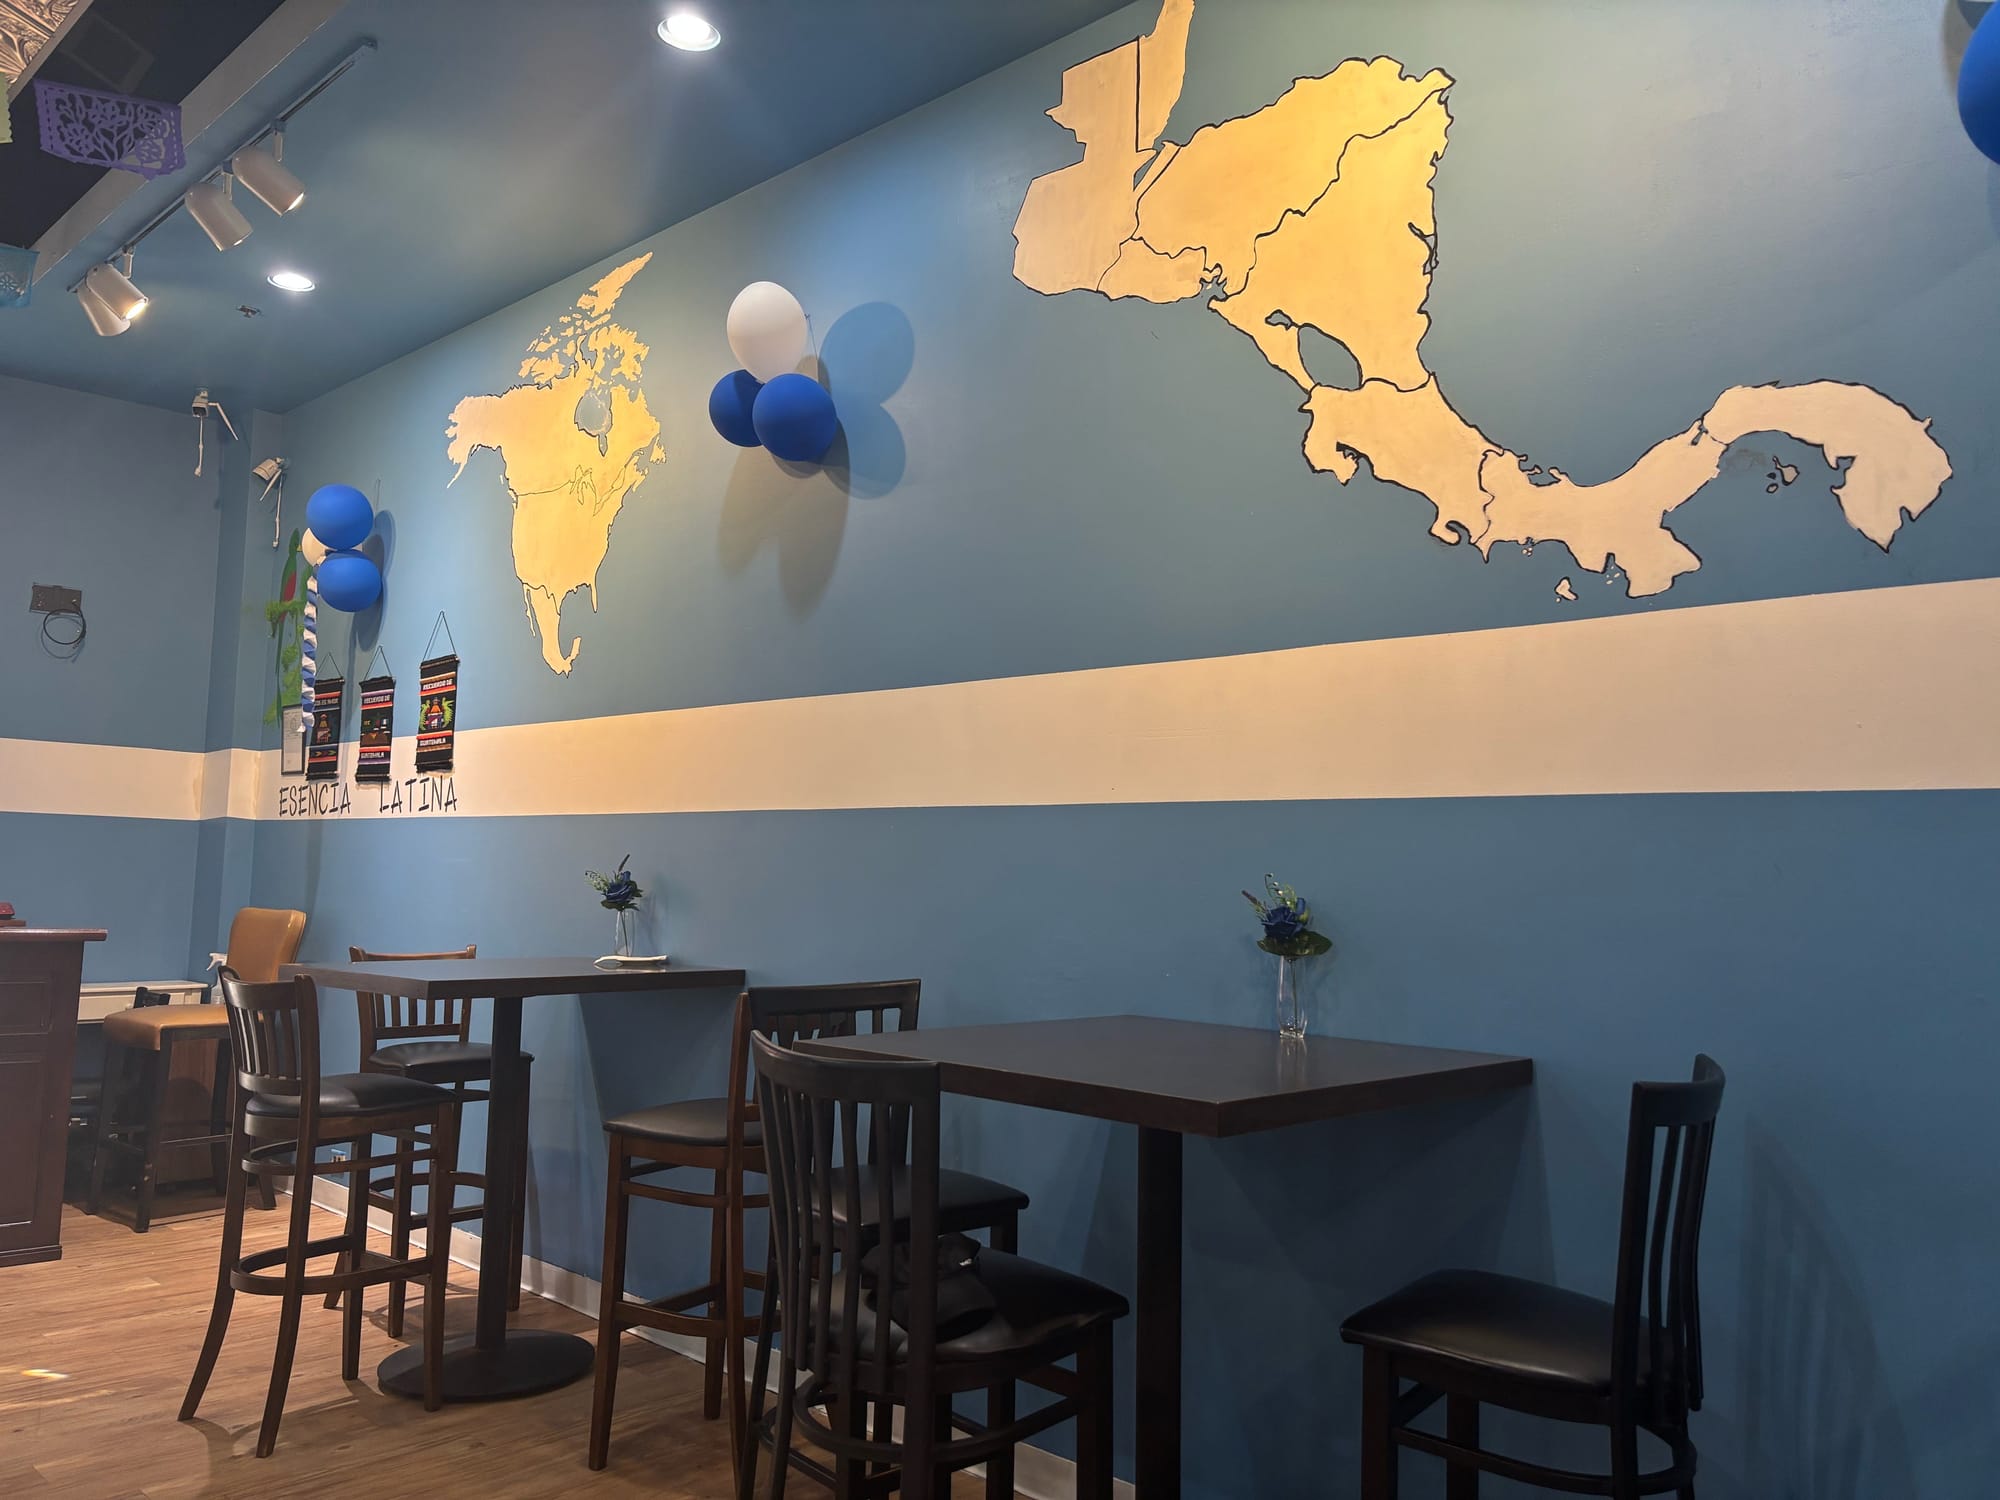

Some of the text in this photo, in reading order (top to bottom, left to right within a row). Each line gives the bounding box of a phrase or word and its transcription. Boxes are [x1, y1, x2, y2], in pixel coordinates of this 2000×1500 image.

[419, 737, 446, 746] GUATEMALA
[279, 775, 457, 817] ESENCIA LATINA
